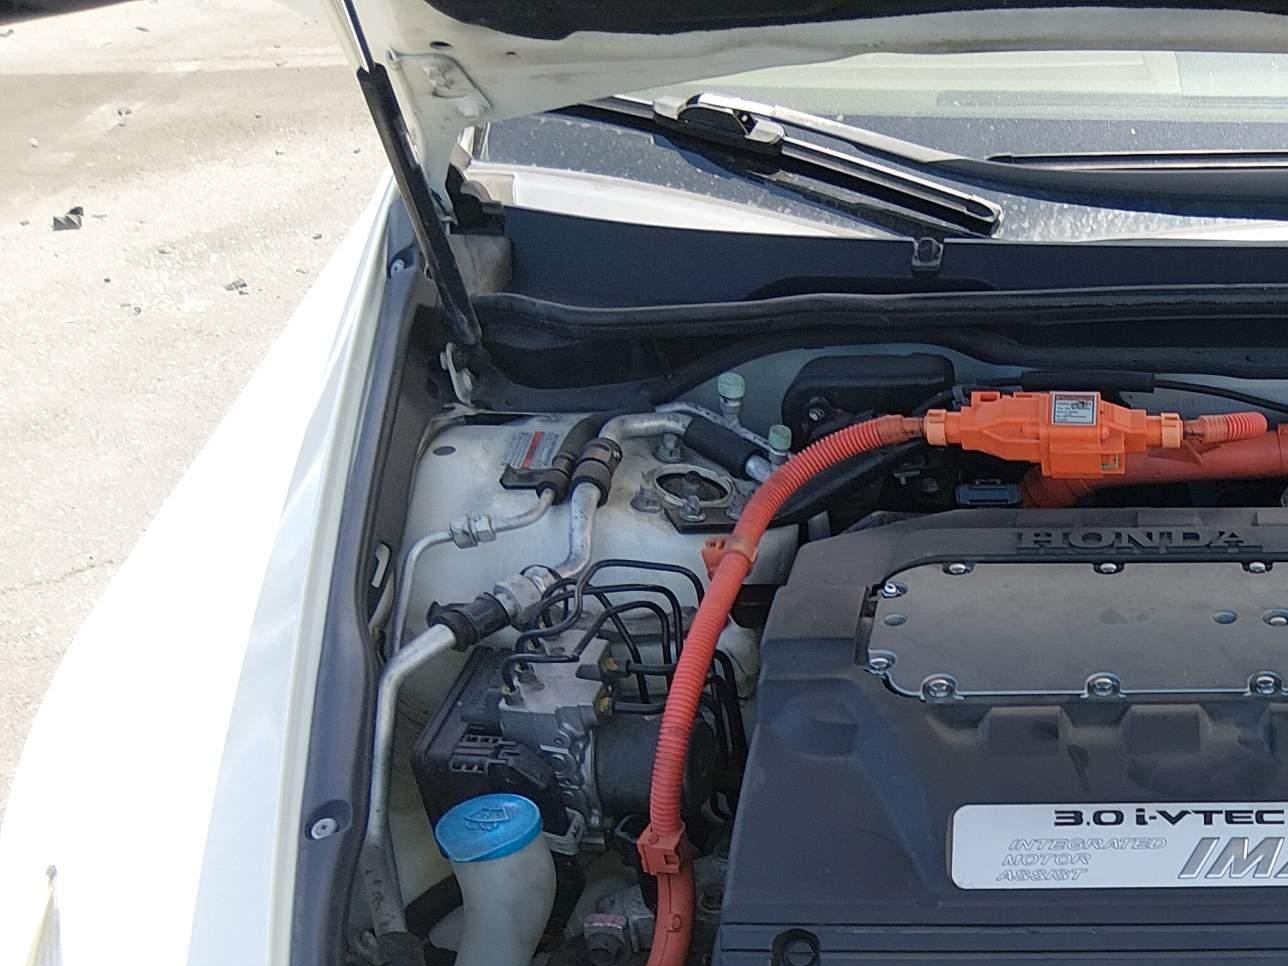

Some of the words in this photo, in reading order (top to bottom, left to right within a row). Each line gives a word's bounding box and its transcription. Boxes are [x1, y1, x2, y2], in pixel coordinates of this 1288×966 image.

[1016, 530, 1262, 554] HONDA
[1053, 809, 1124, 827] 3.0
[1135, 808, 1286, 826] i-VTEC
[1008, 837, 1168, 851] INTEGRATED
[1001, 853, 1091, 867] MOTOR
[996, 868, 1089, 882] ASSIST
